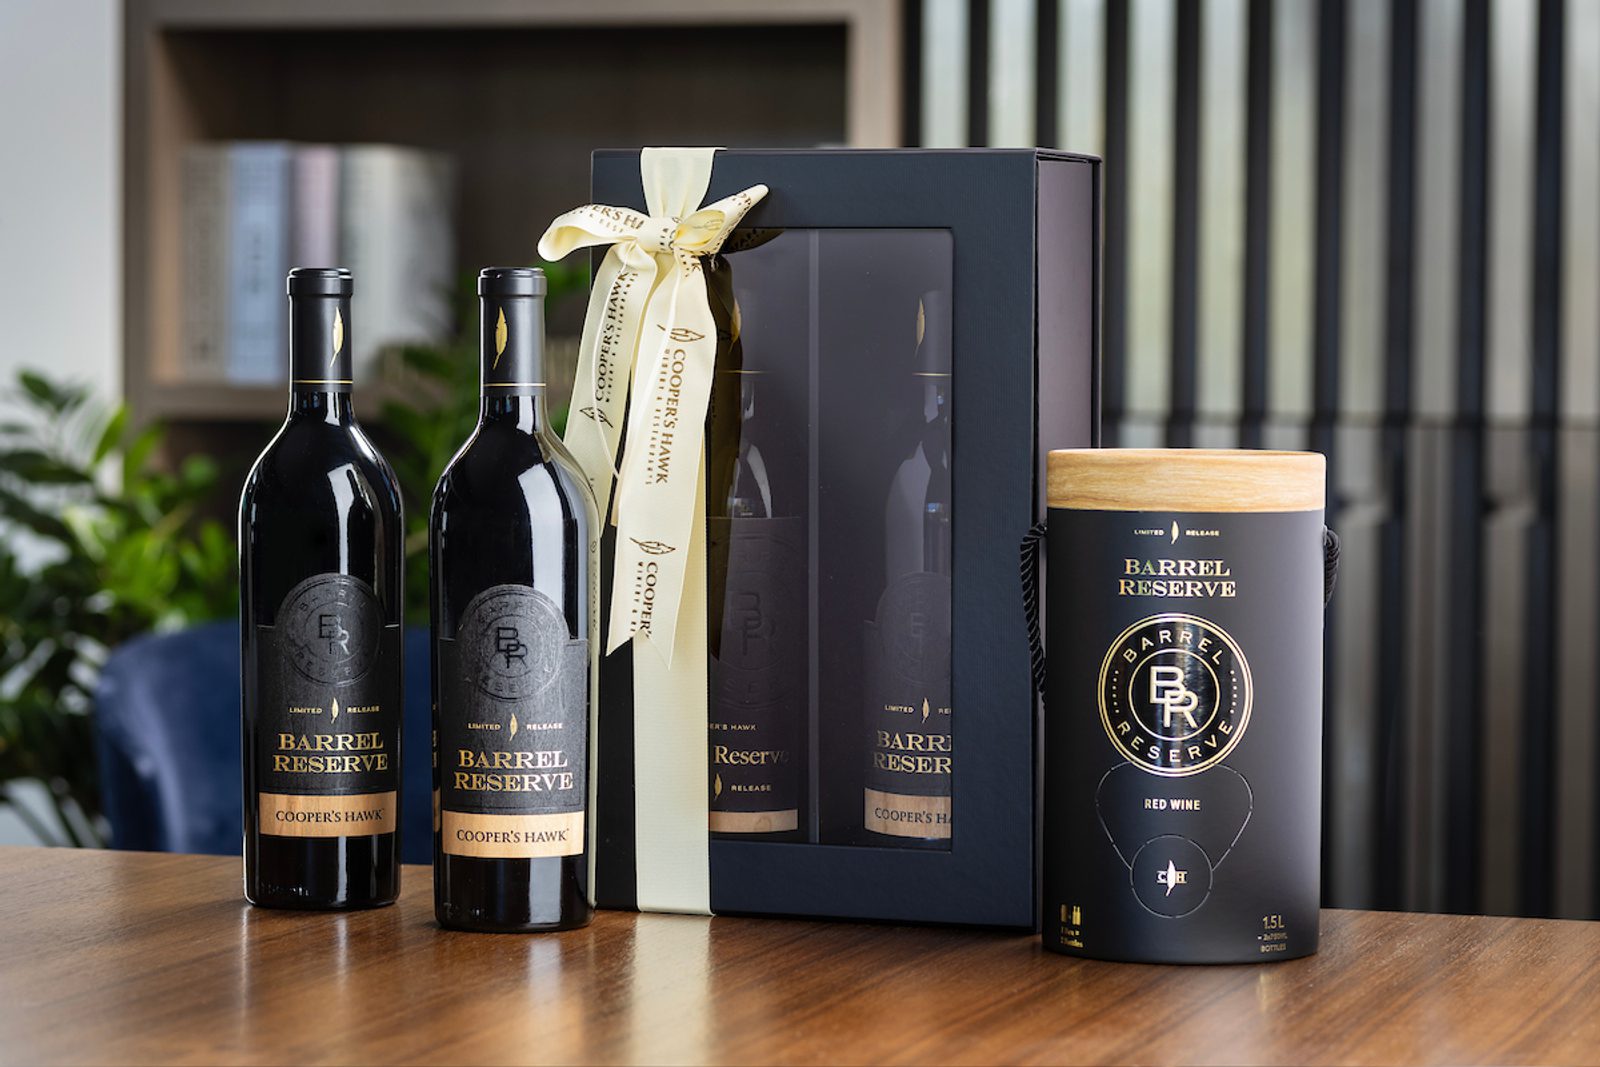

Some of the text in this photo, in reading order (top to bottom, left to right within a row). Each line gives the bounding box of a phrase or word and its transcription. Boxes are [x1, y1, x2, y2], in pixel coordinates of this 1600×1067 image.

[595, 323, 615, 401] COOPER'S
[655, 348, 686, 484] COOPER'S HAWK
[1134, 529, 1165, 537] LIMITED
[1123, 558, 1231, 576] BARREL
[1118, 579, 1236, 598] RESERVE
[1122, 629, 1223, 665] BARREL
[289, 705, 380, 715] LIMITED RELEASE
[884, 704, 915, 714] LIMITED
[467, 722, 563, 731] LIMITED RELEASE
[277, 732, 384, 752] BARREL
[1116, 720, 1233, 763] RESERVE
[272, 753, 389, 774] RESERVE
[458, 749, 568, 770] BARREL
[453, 771, 575, 793] RESERVE
[730, 784, 773, 793] RELEASE
[1144, 798, 1201, 811] RED WINE
[275, 810, 342, 824] COOPER'S
[874, 806, 933, 825] COOPER'S
[456, 828, 521, 844] COOPER'S
